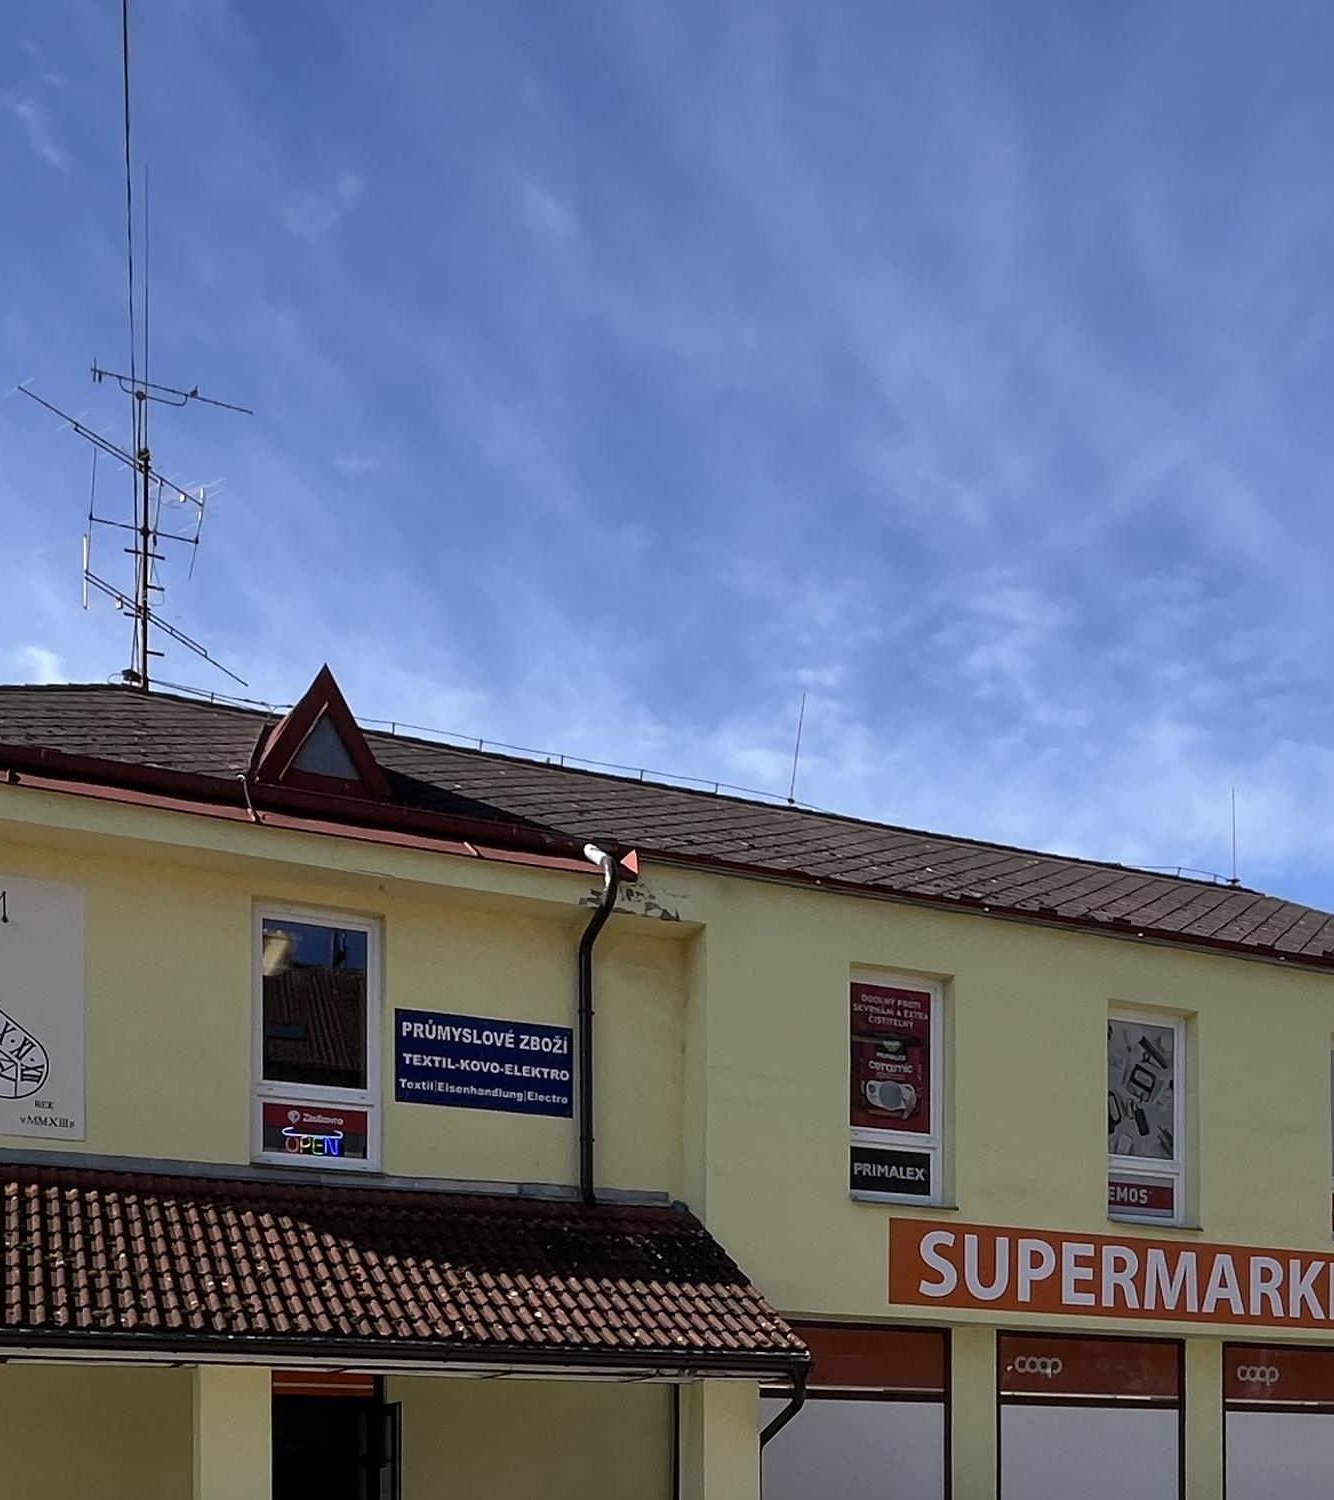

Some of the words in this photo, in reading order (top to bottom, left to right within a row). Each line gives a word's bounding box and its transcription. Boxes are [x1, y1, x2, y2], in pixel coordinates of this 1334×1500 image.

[402, 1019, 515, 1049] PRŮMYSLOVÉ
[519, 1034, 568, 1054] ZBOŽÍ
[403, 1053, 570, 1081] TEXTIL-KOVO-ELEKTRO
[868, 1060, 914, 1074] Ceramic
[285, 1135, 338, 1156] OPEN
[853, 1162, 926, 1181] PRIMALEX
[1109, 1186, 1148, 1204] EMOS
[1015, 1355, 1063, 1379] coop
[1237, 1365, 1280, 1387] coop
